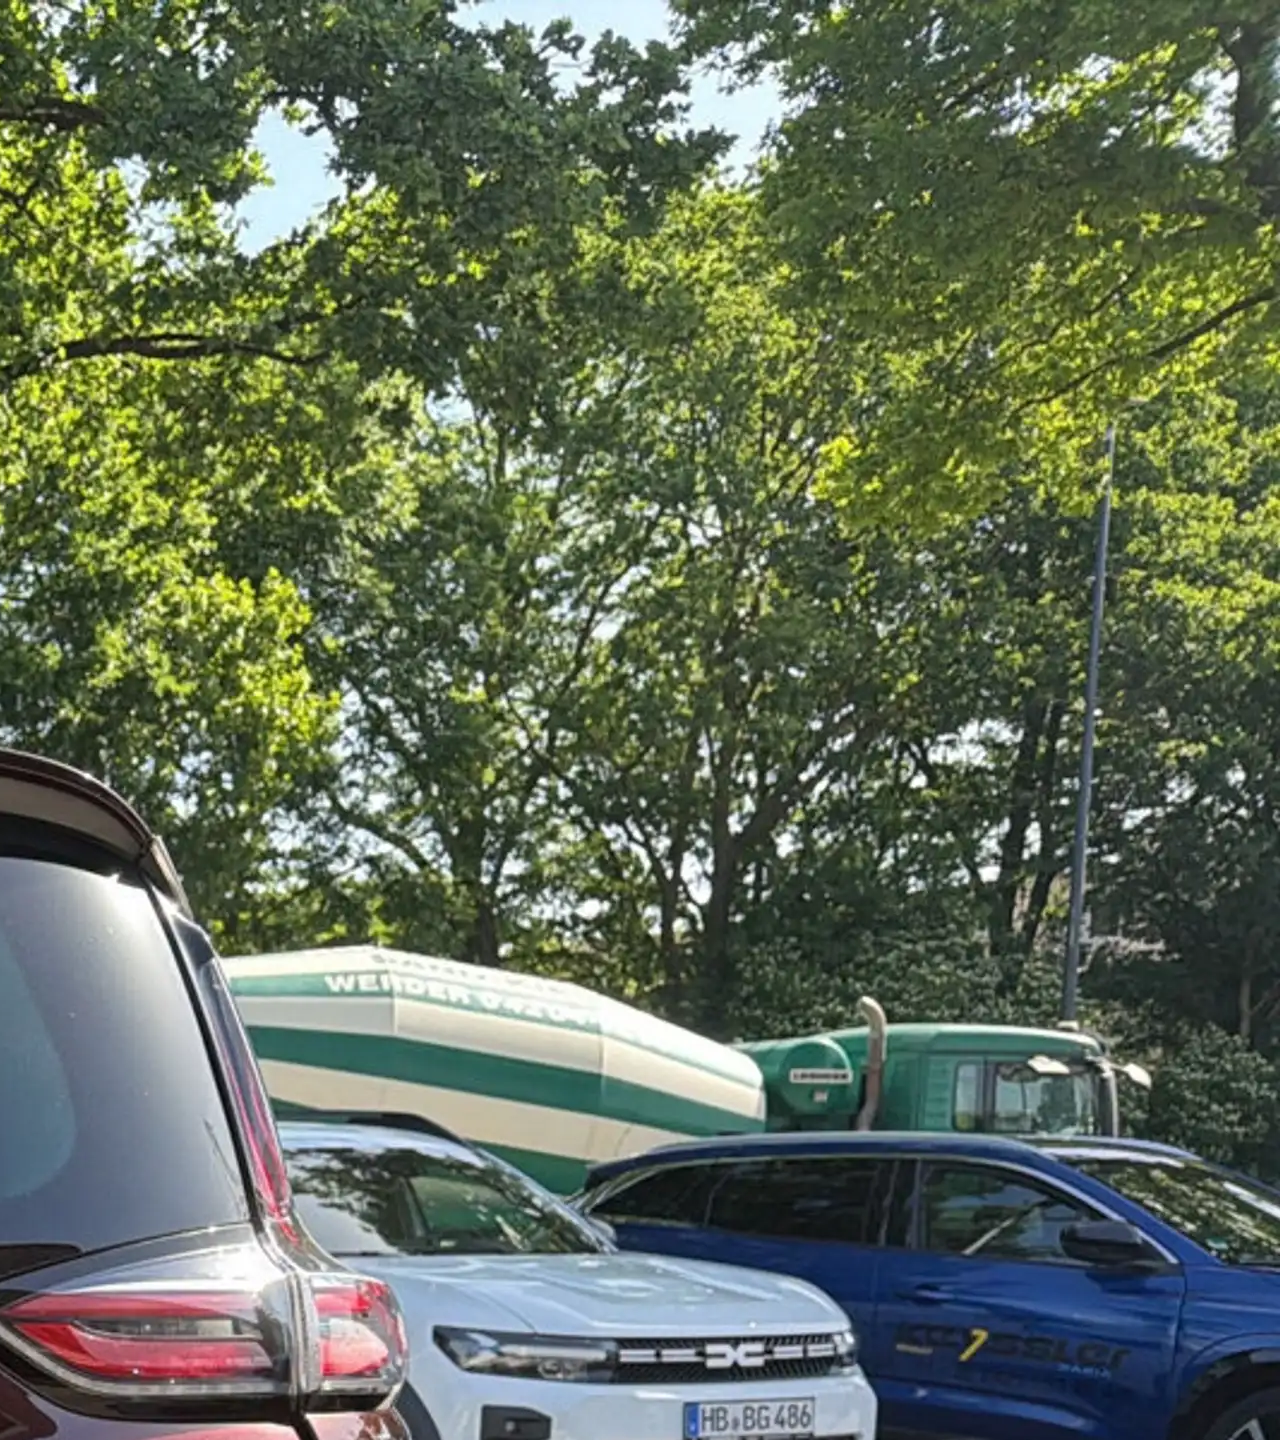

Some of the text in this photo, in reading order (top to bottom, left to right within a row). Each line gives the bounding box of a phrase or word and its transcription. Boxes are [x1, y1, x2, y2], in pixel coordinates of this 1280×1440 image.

[701, 1403, 812, 1433] HB BG 486
